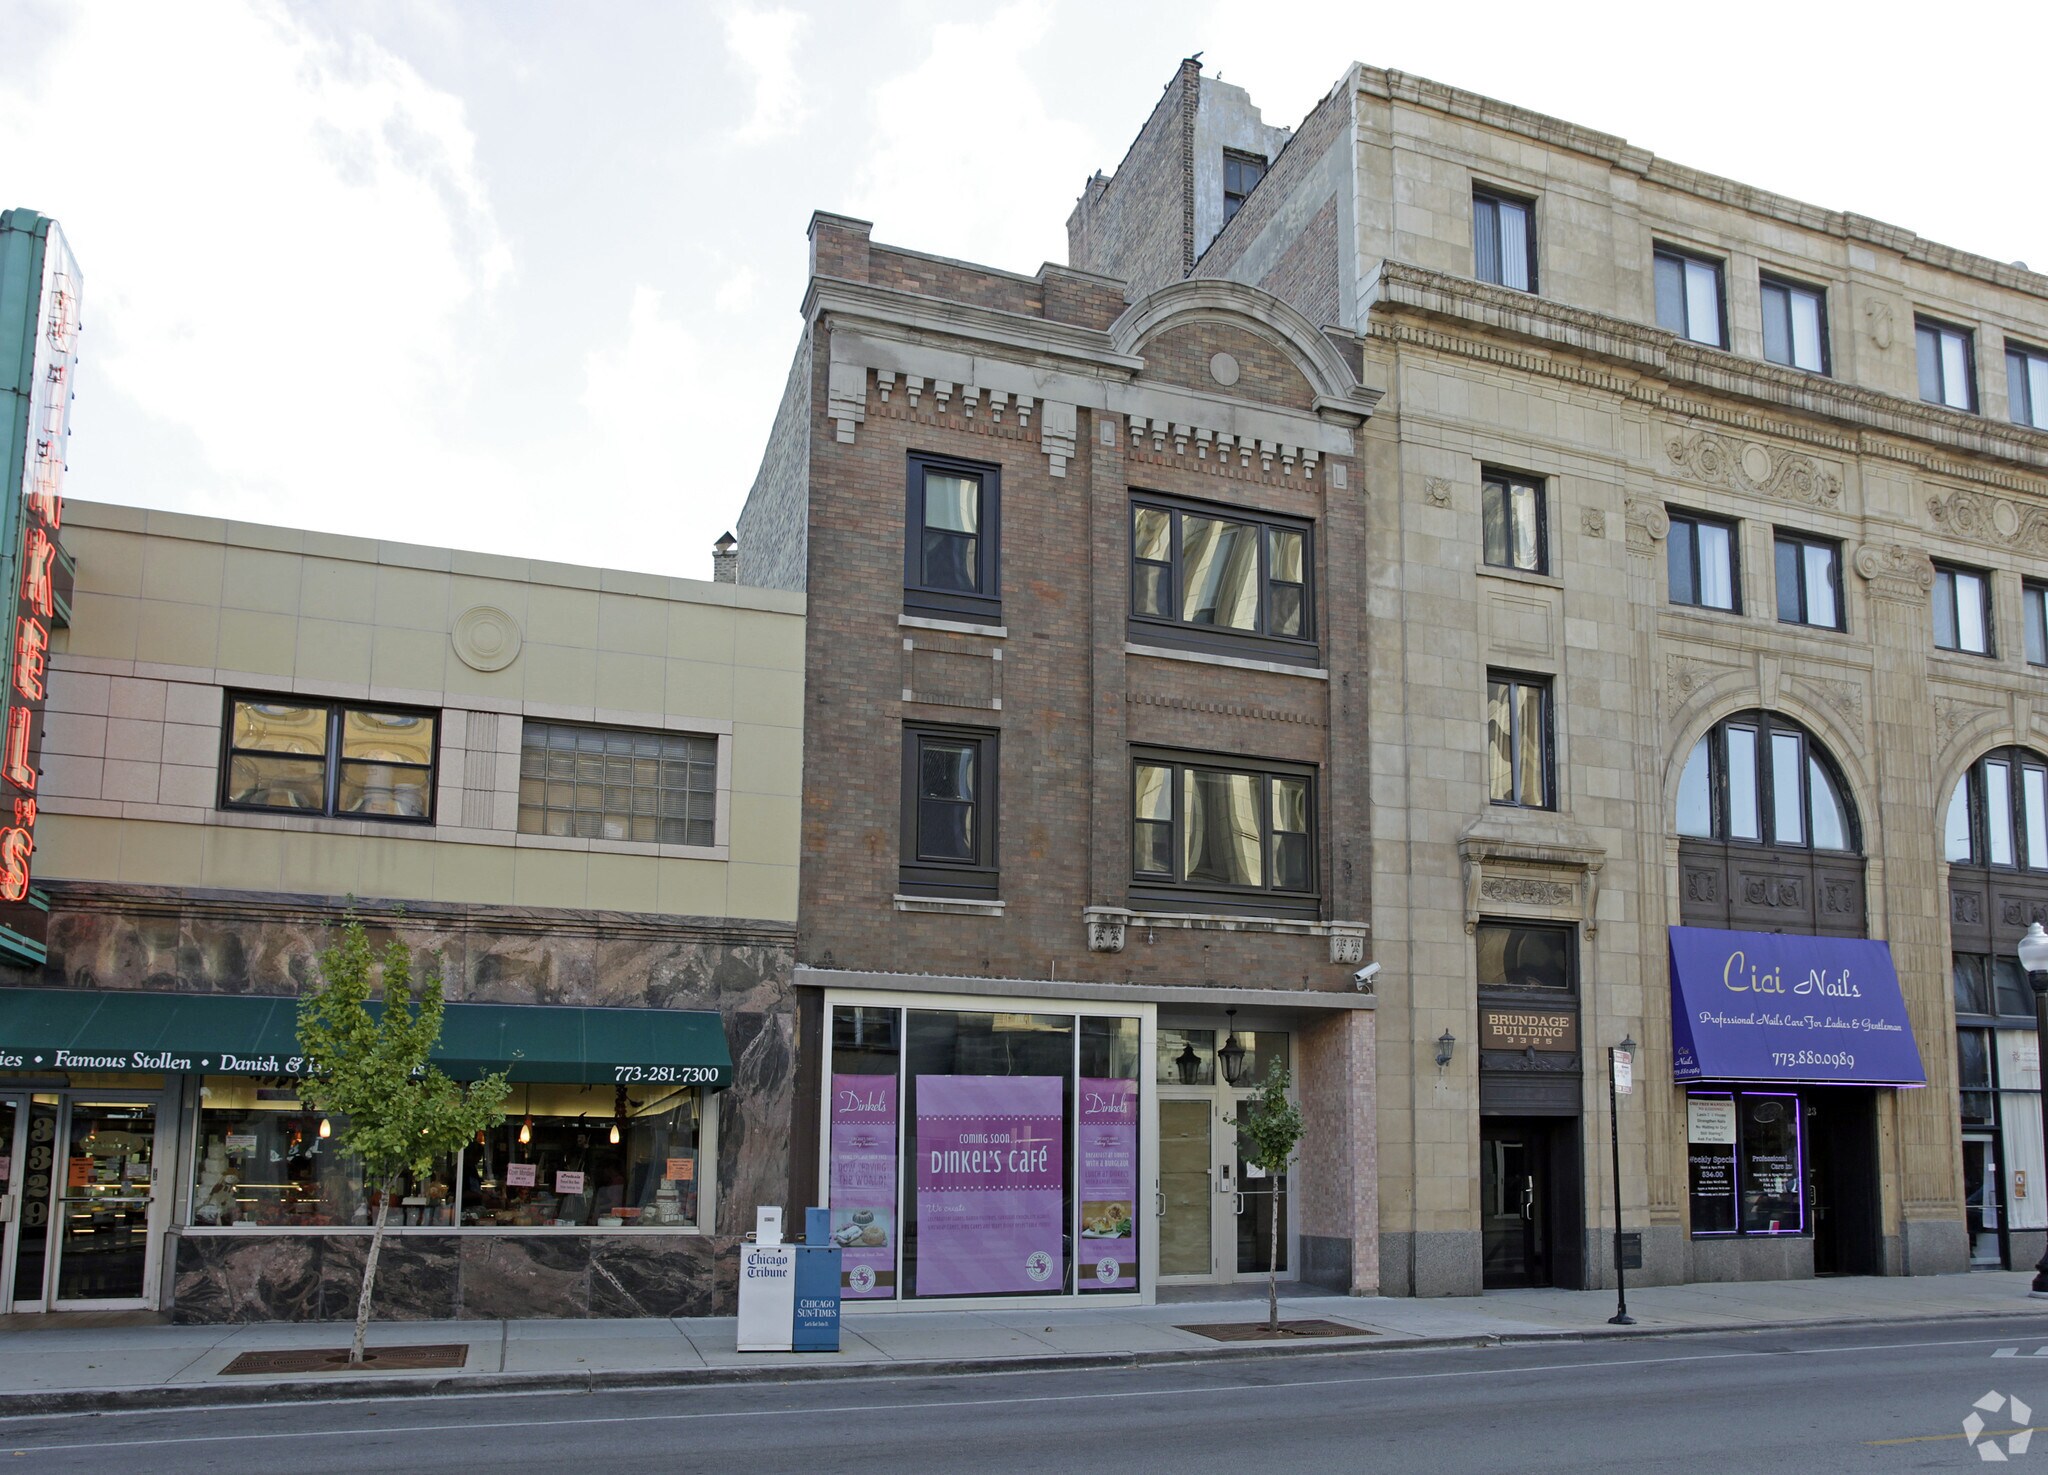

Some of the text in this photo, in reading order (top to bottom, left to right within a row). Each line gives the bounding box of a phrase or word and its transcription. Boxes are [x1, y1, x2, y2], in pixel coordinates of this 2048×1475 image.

[1723, 951, 1862, 998] Cici Nails
[1488, 1014, 1570, 1028] BRUNDAGE
[1699, 1011, 1902, 1032] Professional Nails Care For Ladies & Gentleman
[1493, 1025, 1563, 1037] BUILDING
[54, 1050, 126, 1068] Famous
[131, 1051, 191, 1070] Stollen
[219, 1054, 280, 1072] Danish
[1773, 1050, 1855, 1070] 773.880.0989
[614, 1066, 719, 1082] 773-281-7300
[839, 1090, 886, 1113] Dinkel's
[1085, 1092, 1127, 1114] Dinkel's
[959, 1133, 988, 1144] COMING
[931, 1150, 1001, 1174] DINKEL'S
[747, 1253, 788, 1266] Chicago
[747, 1265, 788, 1278] Tribune
[800, 1299, 835, 1309] CHICAGO
[797, 1308, 837, 1318] SUN-TIMES
